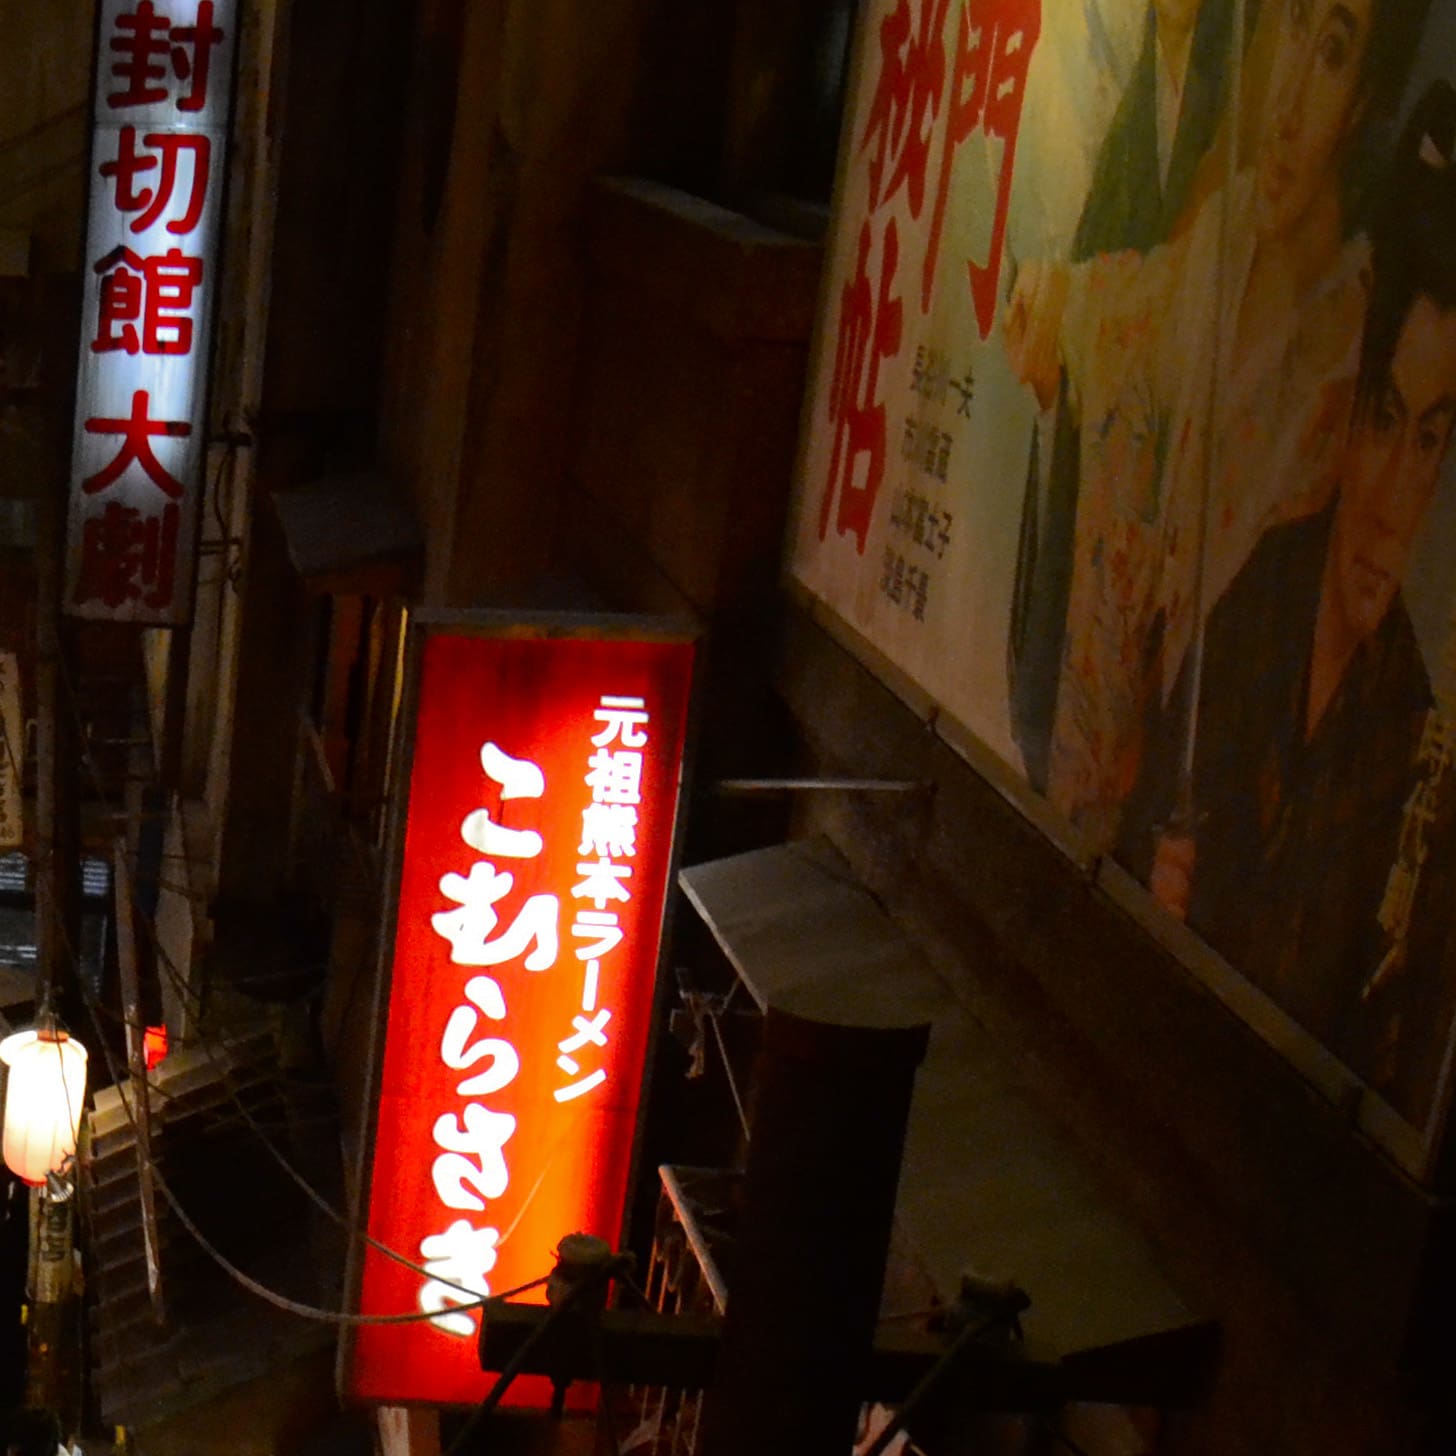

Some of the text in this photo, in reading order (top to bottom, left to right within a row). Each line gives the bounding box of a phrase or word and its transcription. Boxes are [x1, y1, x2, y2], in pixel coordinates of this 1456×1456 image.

[92, 0, 223, 355] 封切館
[417, 740, 562, 1338] こむらさき
[554, 694, 651, 1106] 元祖熊本ラーメン
